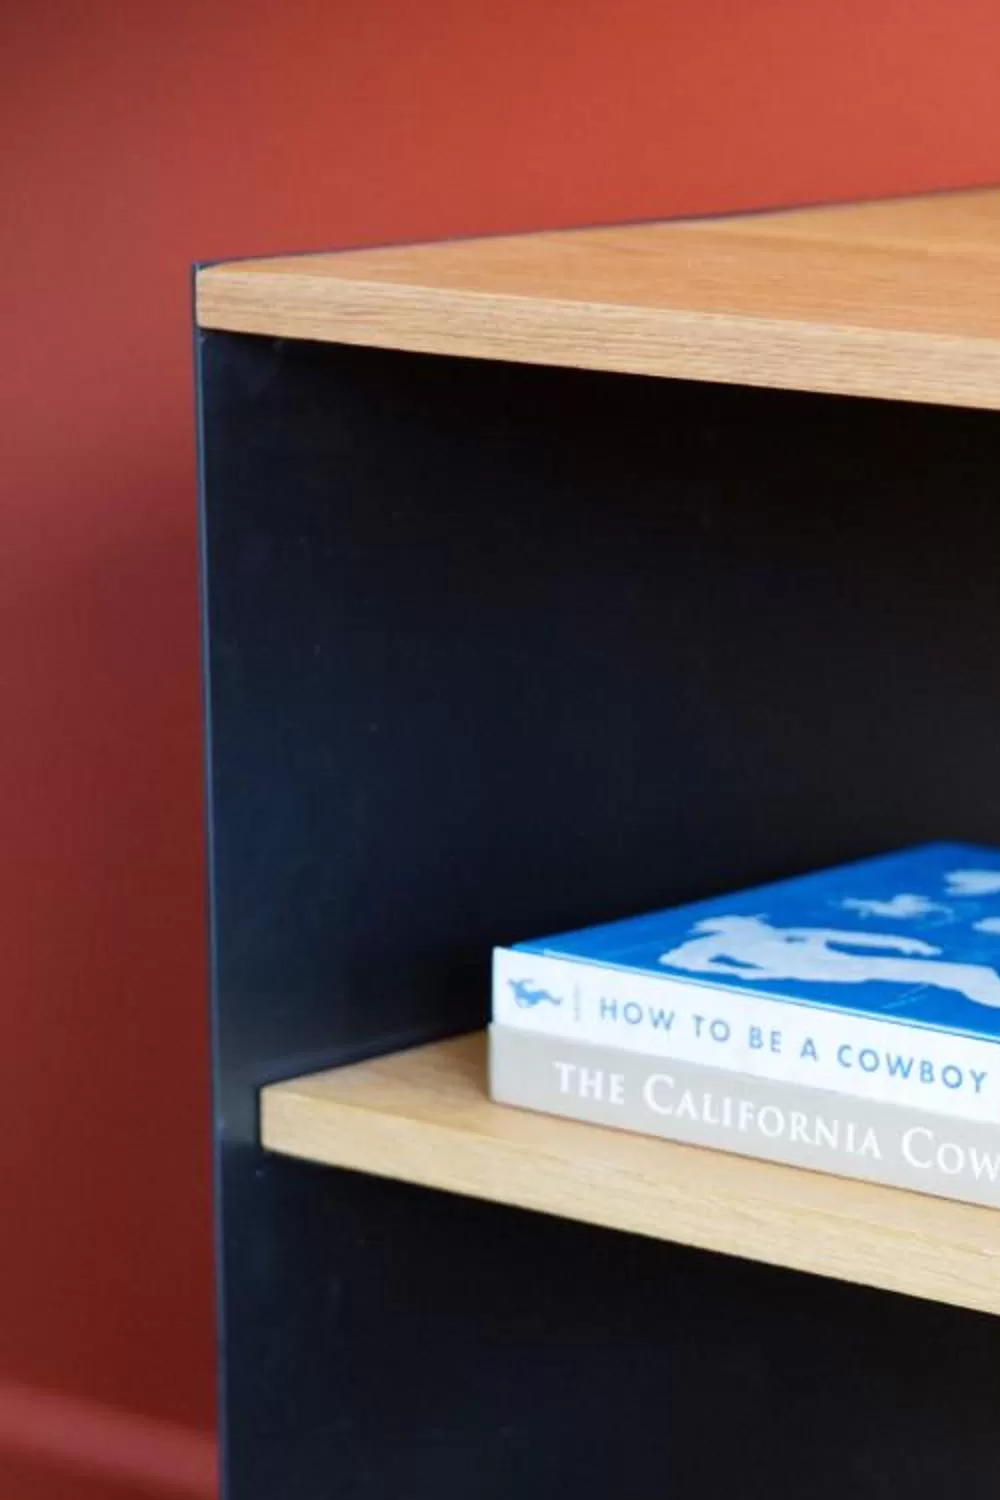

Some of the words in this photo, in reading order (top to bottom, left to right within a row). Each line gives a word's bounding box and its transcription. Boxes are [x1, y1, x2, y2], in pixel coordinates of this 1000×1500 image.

[599, 996, 676, 1033] HOW
[691, 1013, 731, 1043] TO
[748, 1025, 782, 1054] BE
[799, 1036, 820, 1063] A
[836, 1044, 989, 1094] COWBOY
[552, 1060, 626, 1106] THE
